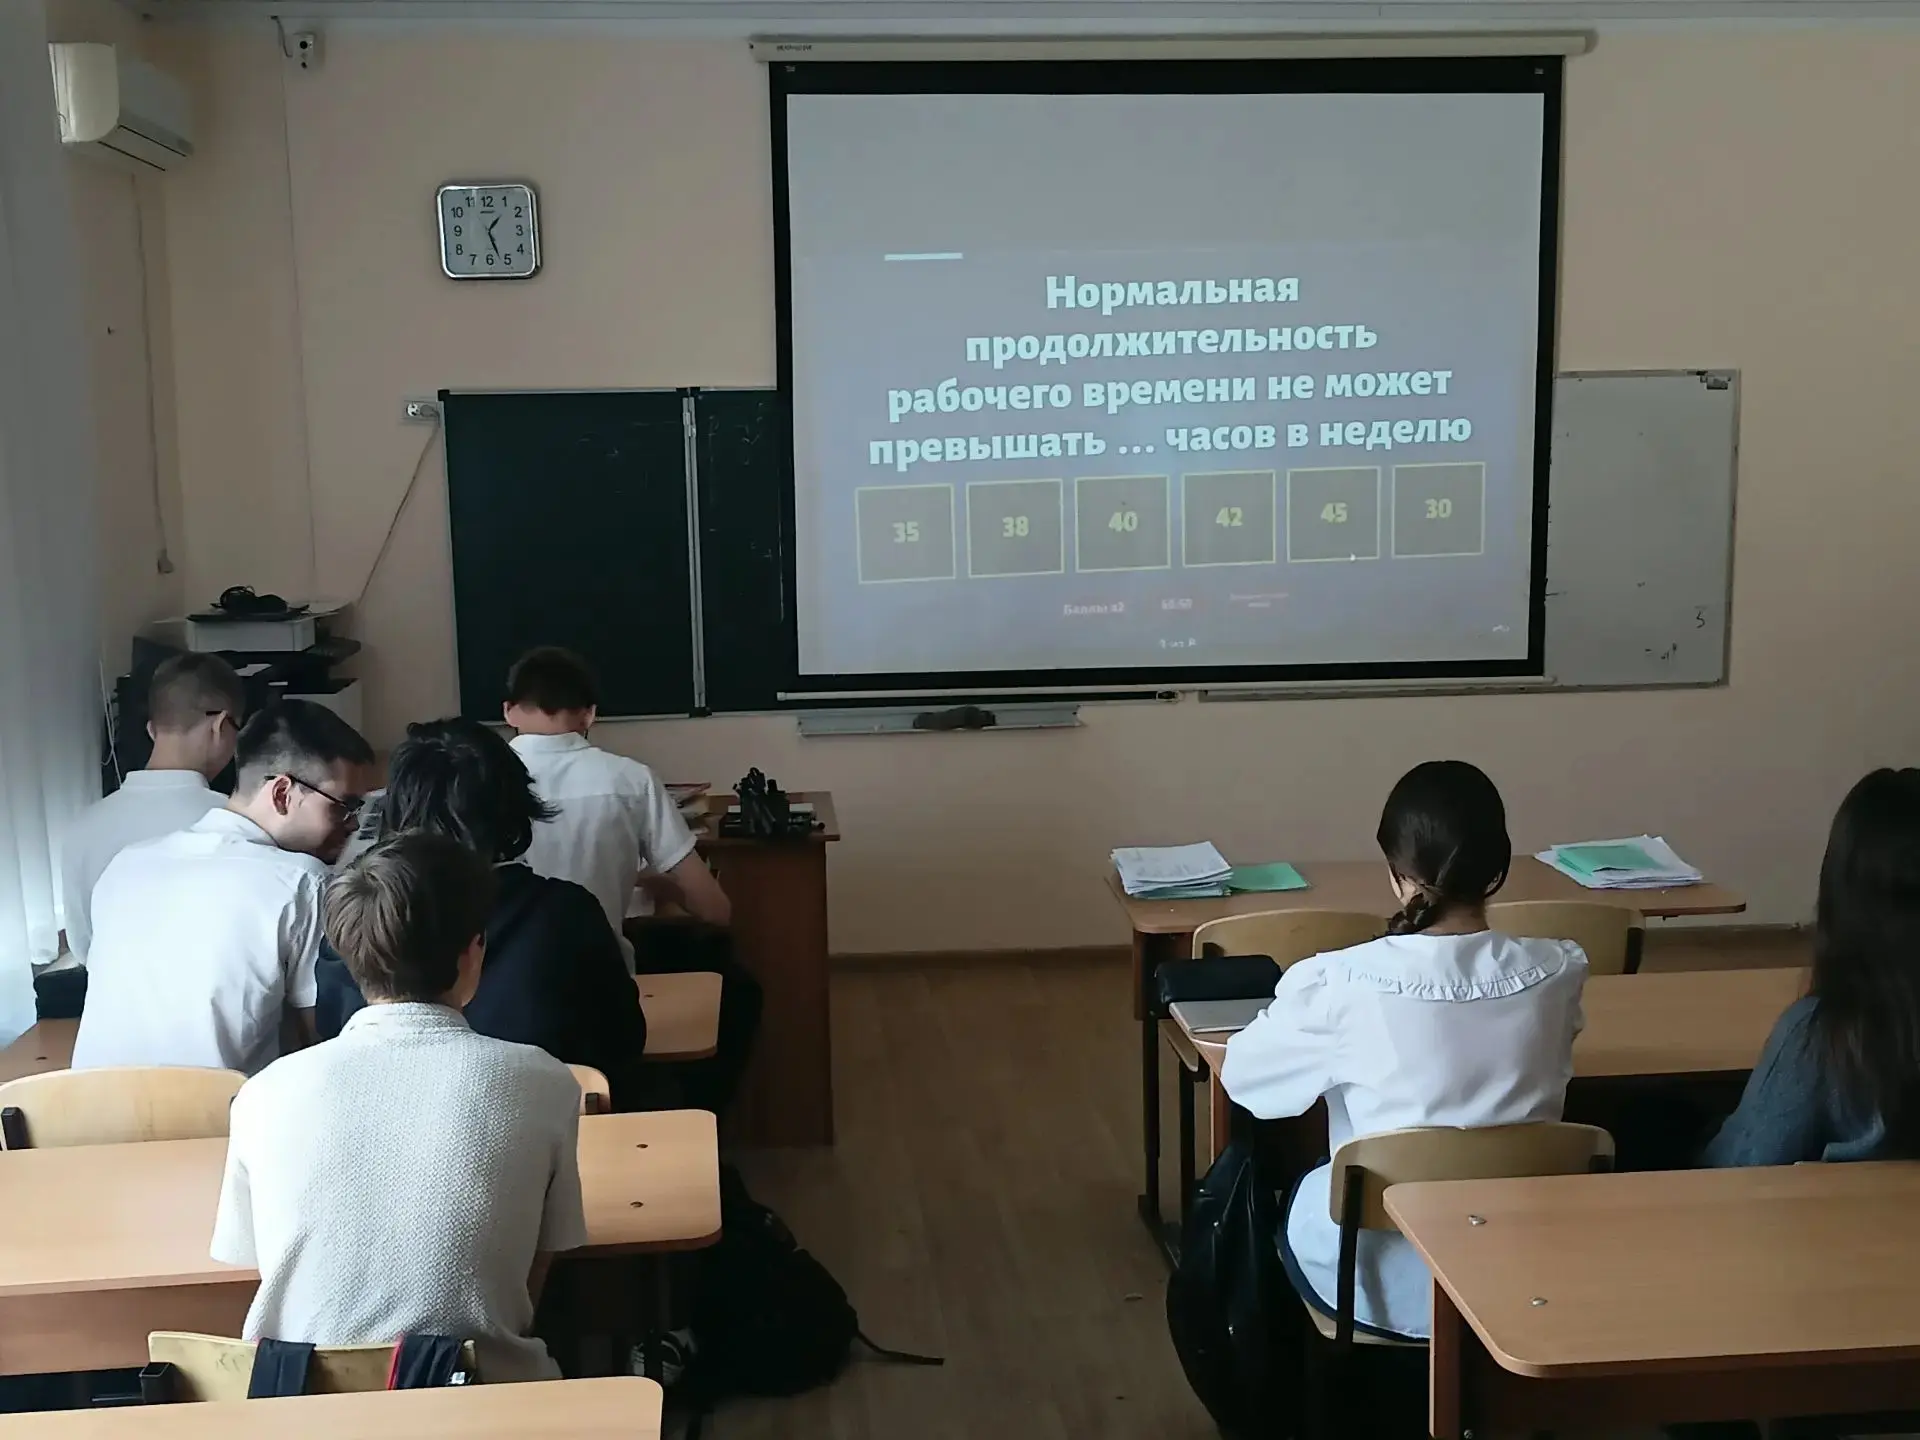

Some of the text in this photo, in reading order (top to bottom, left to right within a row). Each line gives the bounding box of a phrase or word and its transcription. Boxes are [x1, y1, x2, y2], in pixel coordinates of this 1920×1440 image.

[465, 196, 475, 207] 11
[480, 196, 493, 207] 12
[502, 196, 507, 207] 1
[451, 207, 463, 218] 10
[514, 207, 522, 218] 2
[454, 225, 462, 237] 9
[516, 225, 523, 236] 3
[456, 244, 463, 255] 8
[517, 244, 524, 255] 4
[470, 254, 477, 265] 7
[486, 254, 494, 265] 6
[504, 254, 511, 265] 5
[1046, 275, 1299, 316] Нормальная
[966, 325, 1377, 369] продолжительность
[888, 370, 1452, 423] рабочего времени не может
[869, 431, 1106, 472] превышать
[1166, 423, 1276, 451] часов
[1287, 423, 1309, 448] в
[1320, 418, 1472, 451] неделю
[1321, 502, 1348, 524] 45
[1425, 498, 1452, 519] 30
[1109, 511, 1138, 533] 40
[1215, 506, 1243, 528] 42
[893, 522, 920, 543] 35
[1002, 516, 1029, 538] 38
